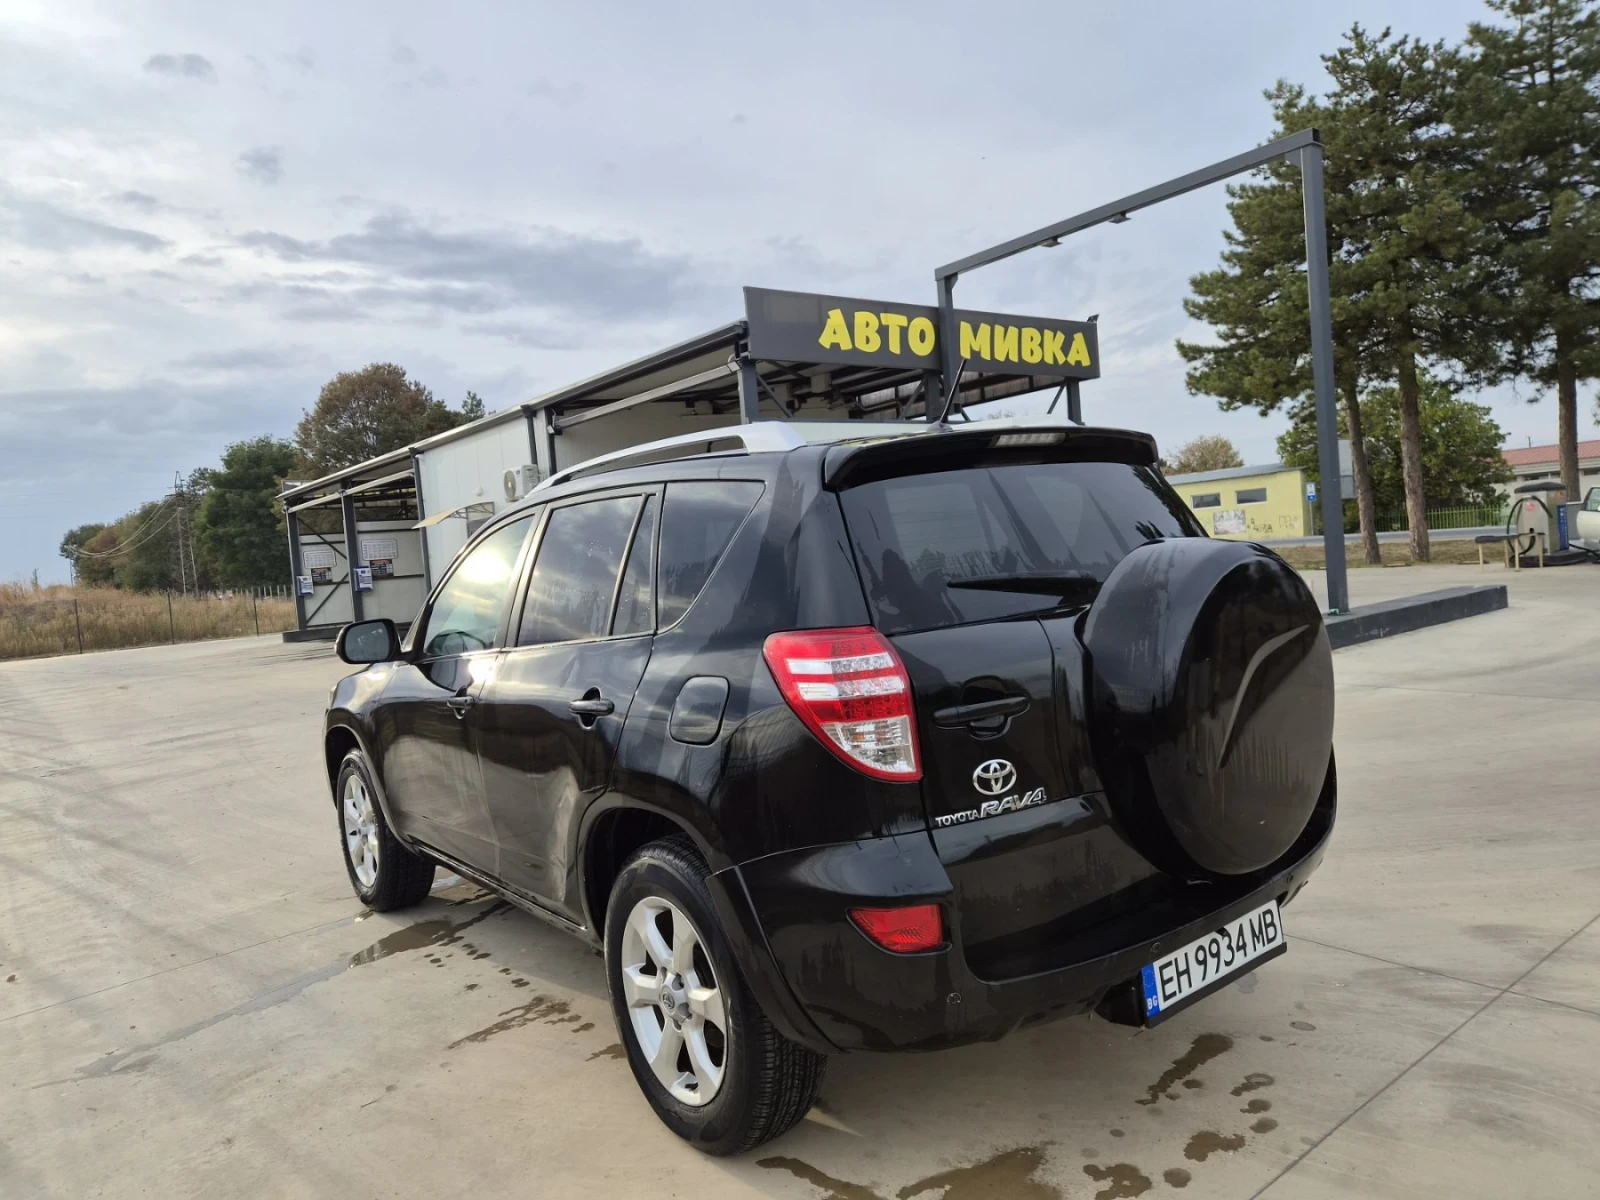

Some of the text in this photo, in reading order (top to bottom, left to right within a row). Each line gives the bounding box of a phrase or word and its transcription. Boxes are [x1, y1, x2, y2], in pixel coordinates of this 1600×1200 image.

[818, 308, 1091, 367] АВТО МИВКА
[935, 787, 1047, 827] TOYOTA RAV4
[1158, 908, 1278, 1003] EH 9934 MB
[1146, 995, 1158, 1010] BG
